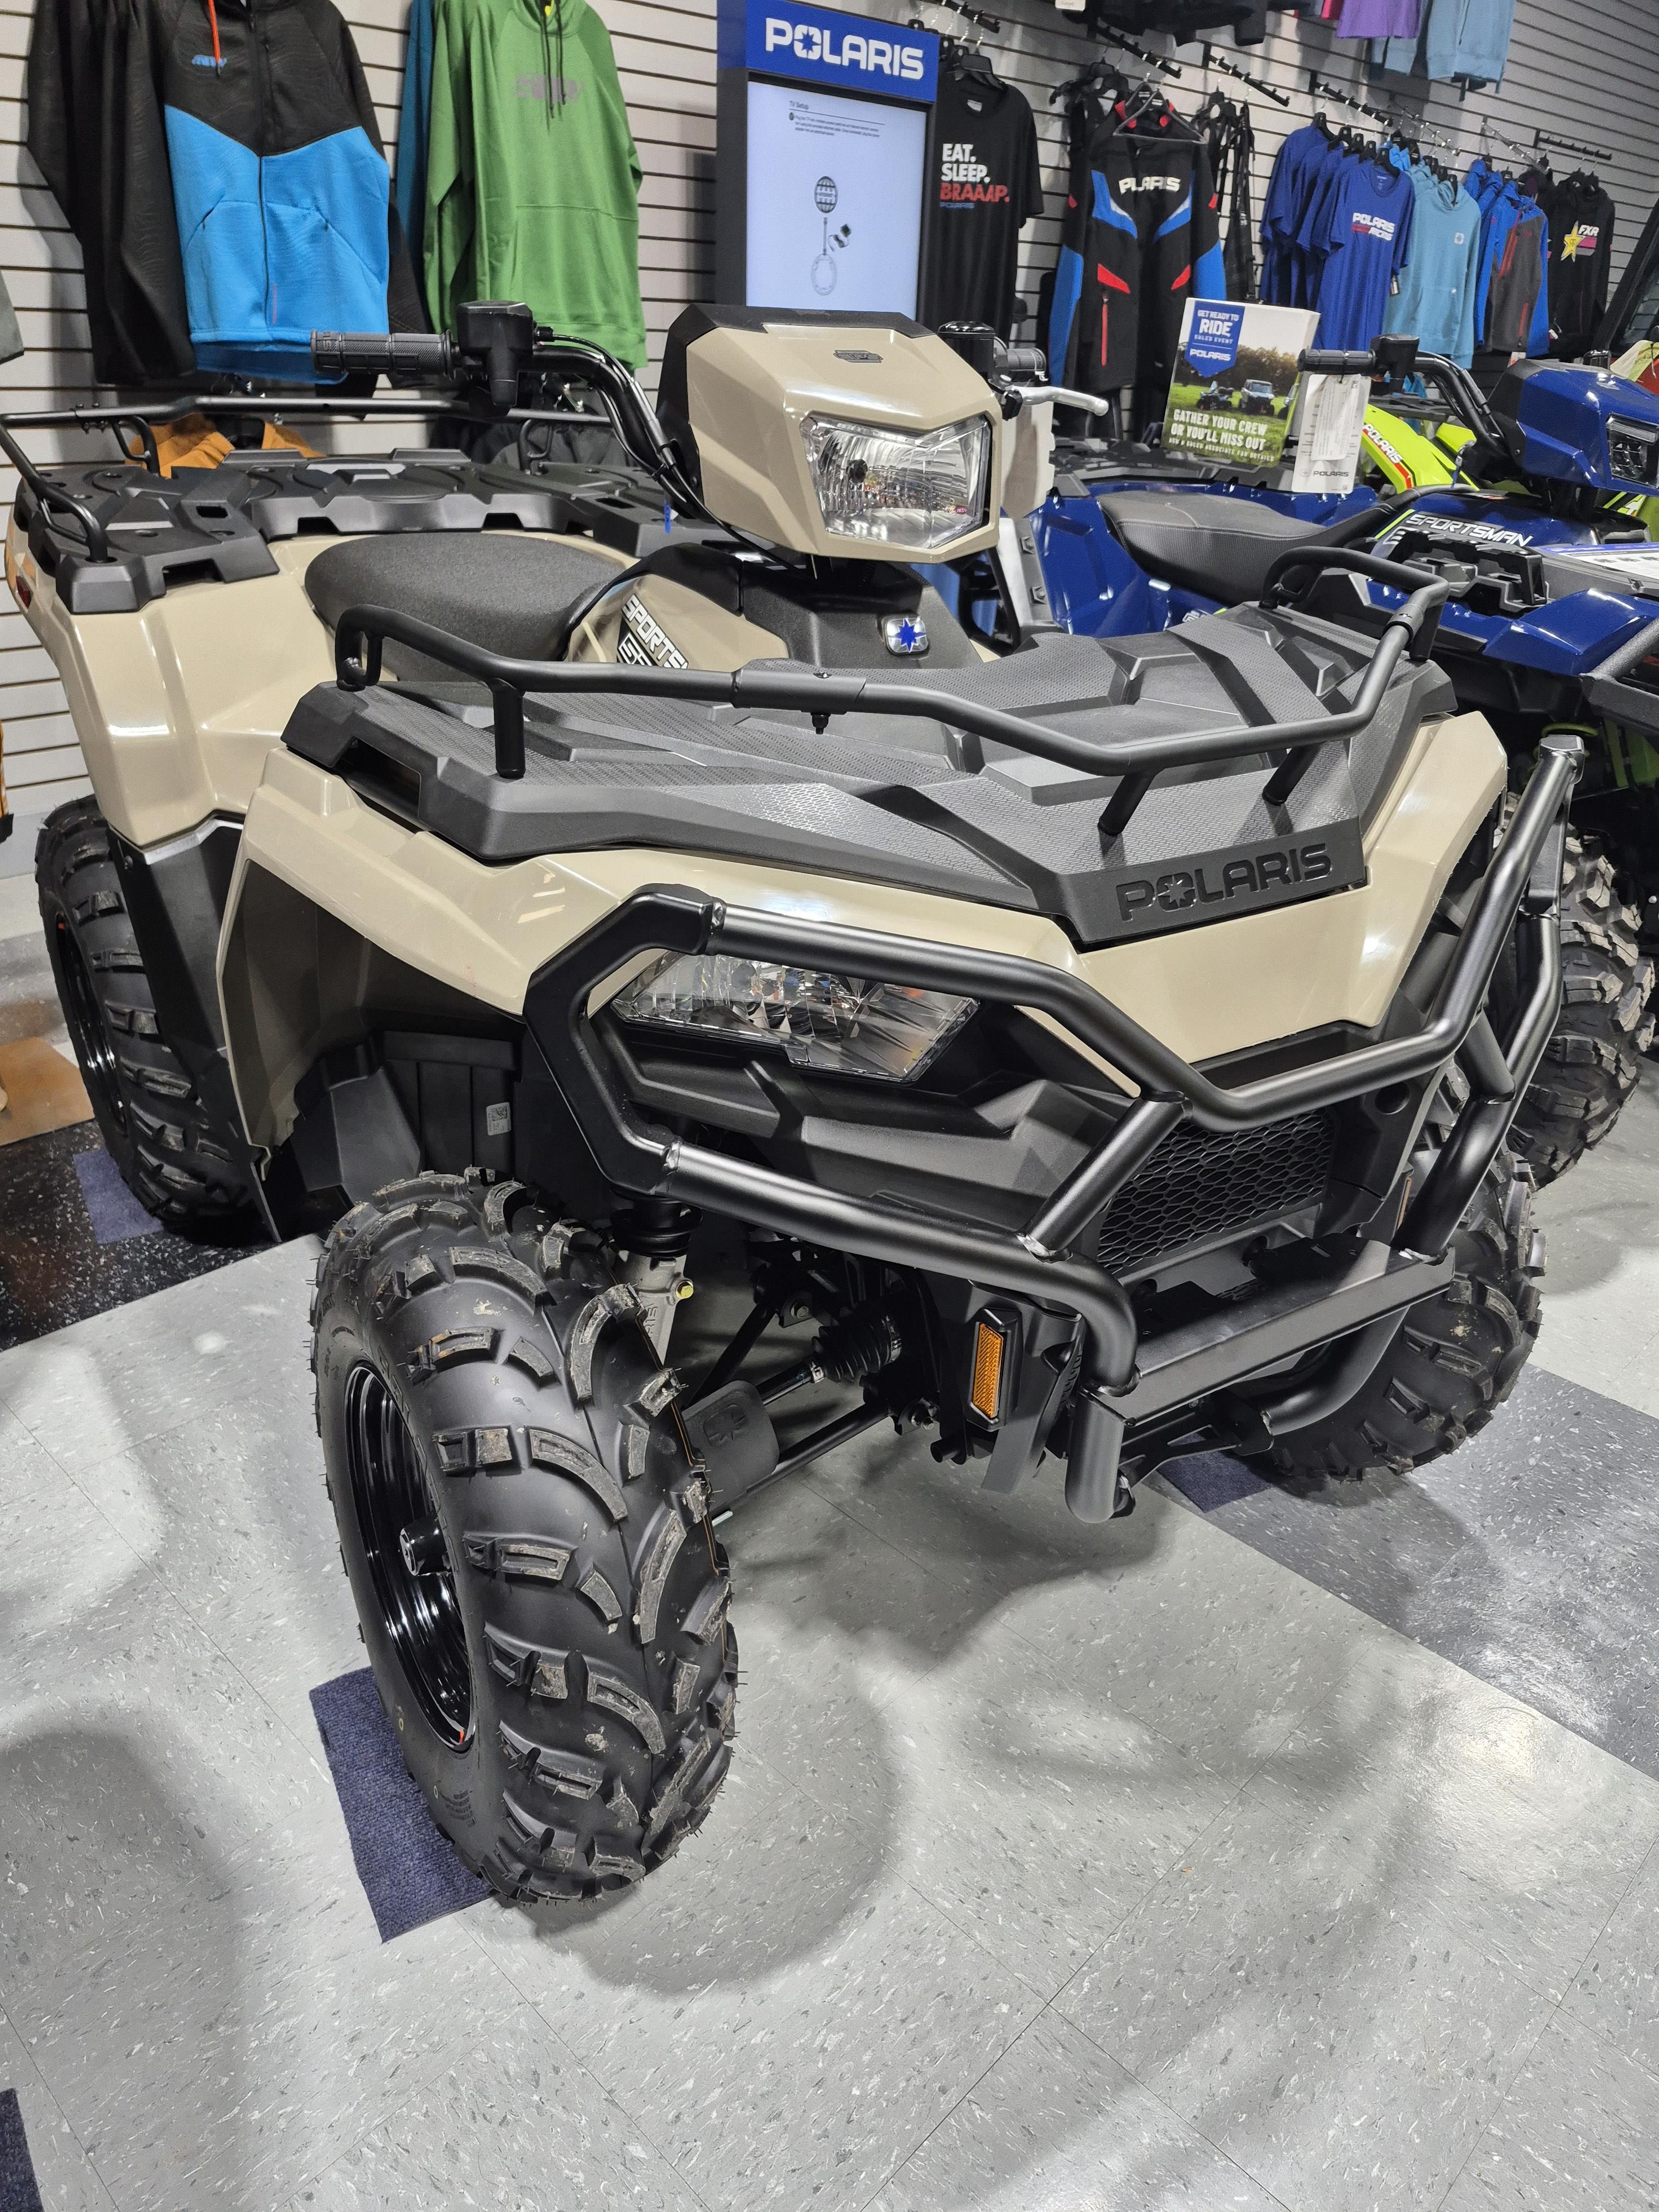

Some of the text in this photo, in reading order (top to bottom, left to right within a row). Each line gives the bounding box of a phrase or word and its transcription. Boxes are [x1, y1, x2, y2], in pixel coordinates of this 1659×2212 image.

[765, 17, 924, 80] POLARIS
[942, 143, 976, 162] EAT.
[941, 163, 990, 183] SLEEP.
[940, 183, 1010, 202] BRAAAP.
[1353, 212, 1395, 233] POLARIS
[1578, 225, 1599, 237] FXR
[1209, 311, 1230, 320] READY
[1199, 319, 1233, 337] RIDE
[1190, 348, 1232, 361] POLARIS
[1173, 409, 1268, 436] GATHER YOUR CREW
[1171, 423, 1267, 451] OR YOU'LL MISS OUT
[1363, 422, 1403, 463] POLARIS
[1405, 514, 1533, 547] SPORTSMAN
[622, 593, 689, 669] SPORTS
[1115, 843, 1333, 923] POLARIS
